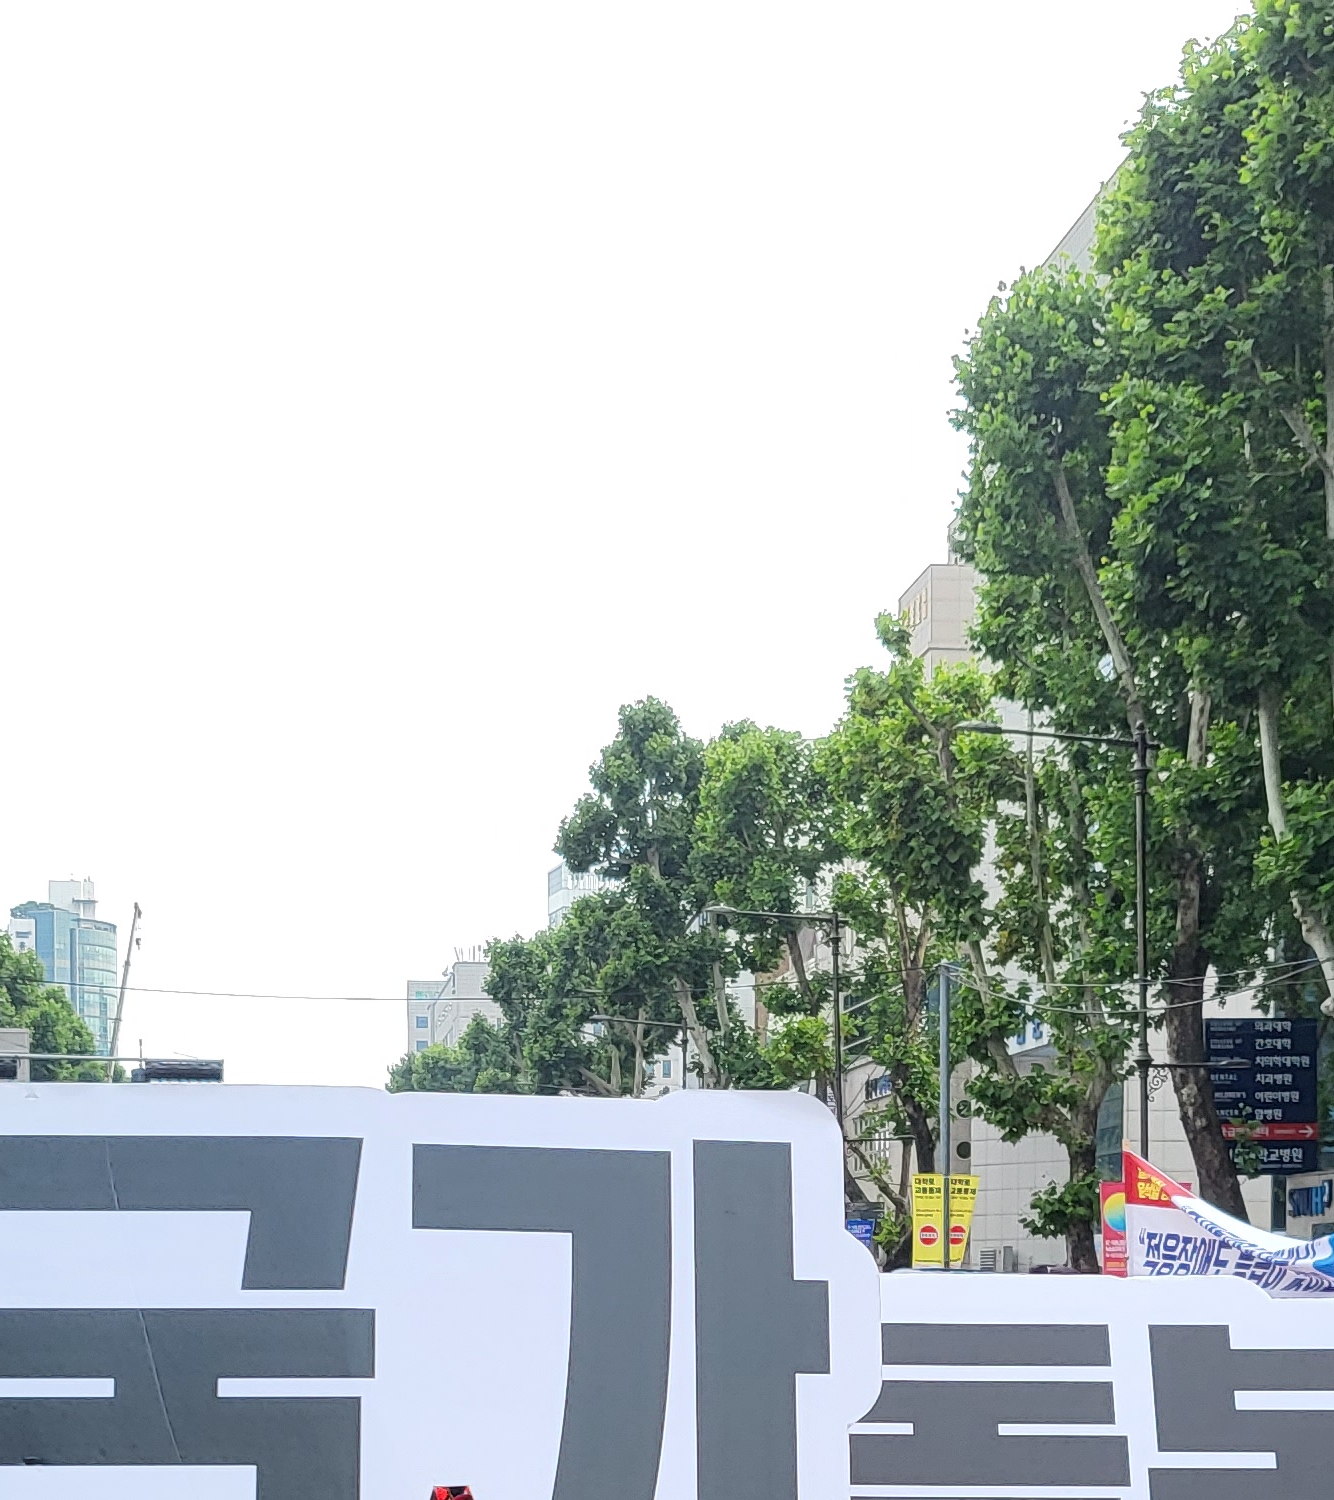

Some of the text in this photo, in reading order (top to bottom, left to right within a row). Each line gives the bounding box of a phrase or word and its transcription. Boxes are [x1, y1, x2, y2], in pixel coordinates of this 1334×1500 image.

[1254, 1021, 1292, 1033] 의과대학
[1254, 1038, 1292, 1050] 간호대학
[1254, 1055, 1310, 1068] 치의학대학원
[1254, 1073, 1293, 1085] 치과병원
[1254, 1091, 1300, 1103] 어린이병원
[1254, 1108, 1283, 1120] 암병원
